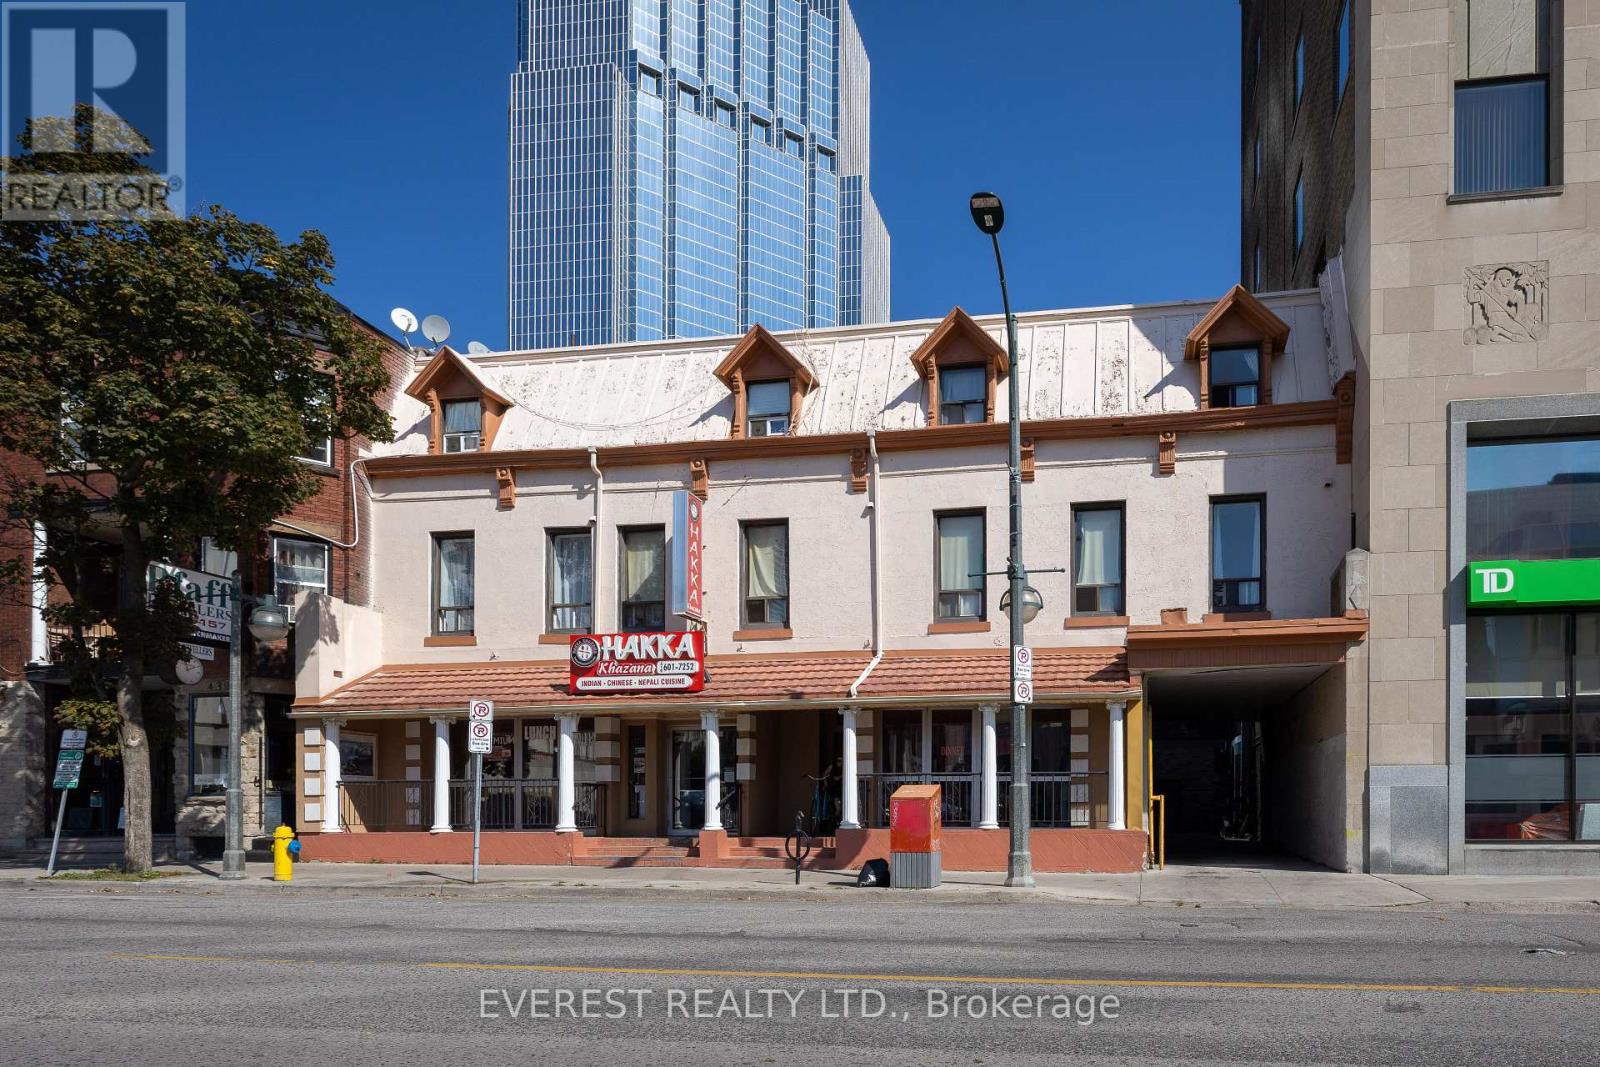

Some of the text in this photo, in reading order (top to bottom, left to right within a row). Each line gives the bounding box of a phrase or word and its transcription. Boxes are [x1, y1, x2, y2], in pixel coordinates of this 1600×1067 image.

[689, 523, 699, 607] HAKKA
[1475, 568, 1514, 593] TD
[601, 633, 696, 661] HAKKA
[598, 661, 656, 675] Khazana
[663, 662, 695, 672] 601-7252
[607, 679, 633, 687] CHINESE
[524, 725, 557, 740] LUNCH
